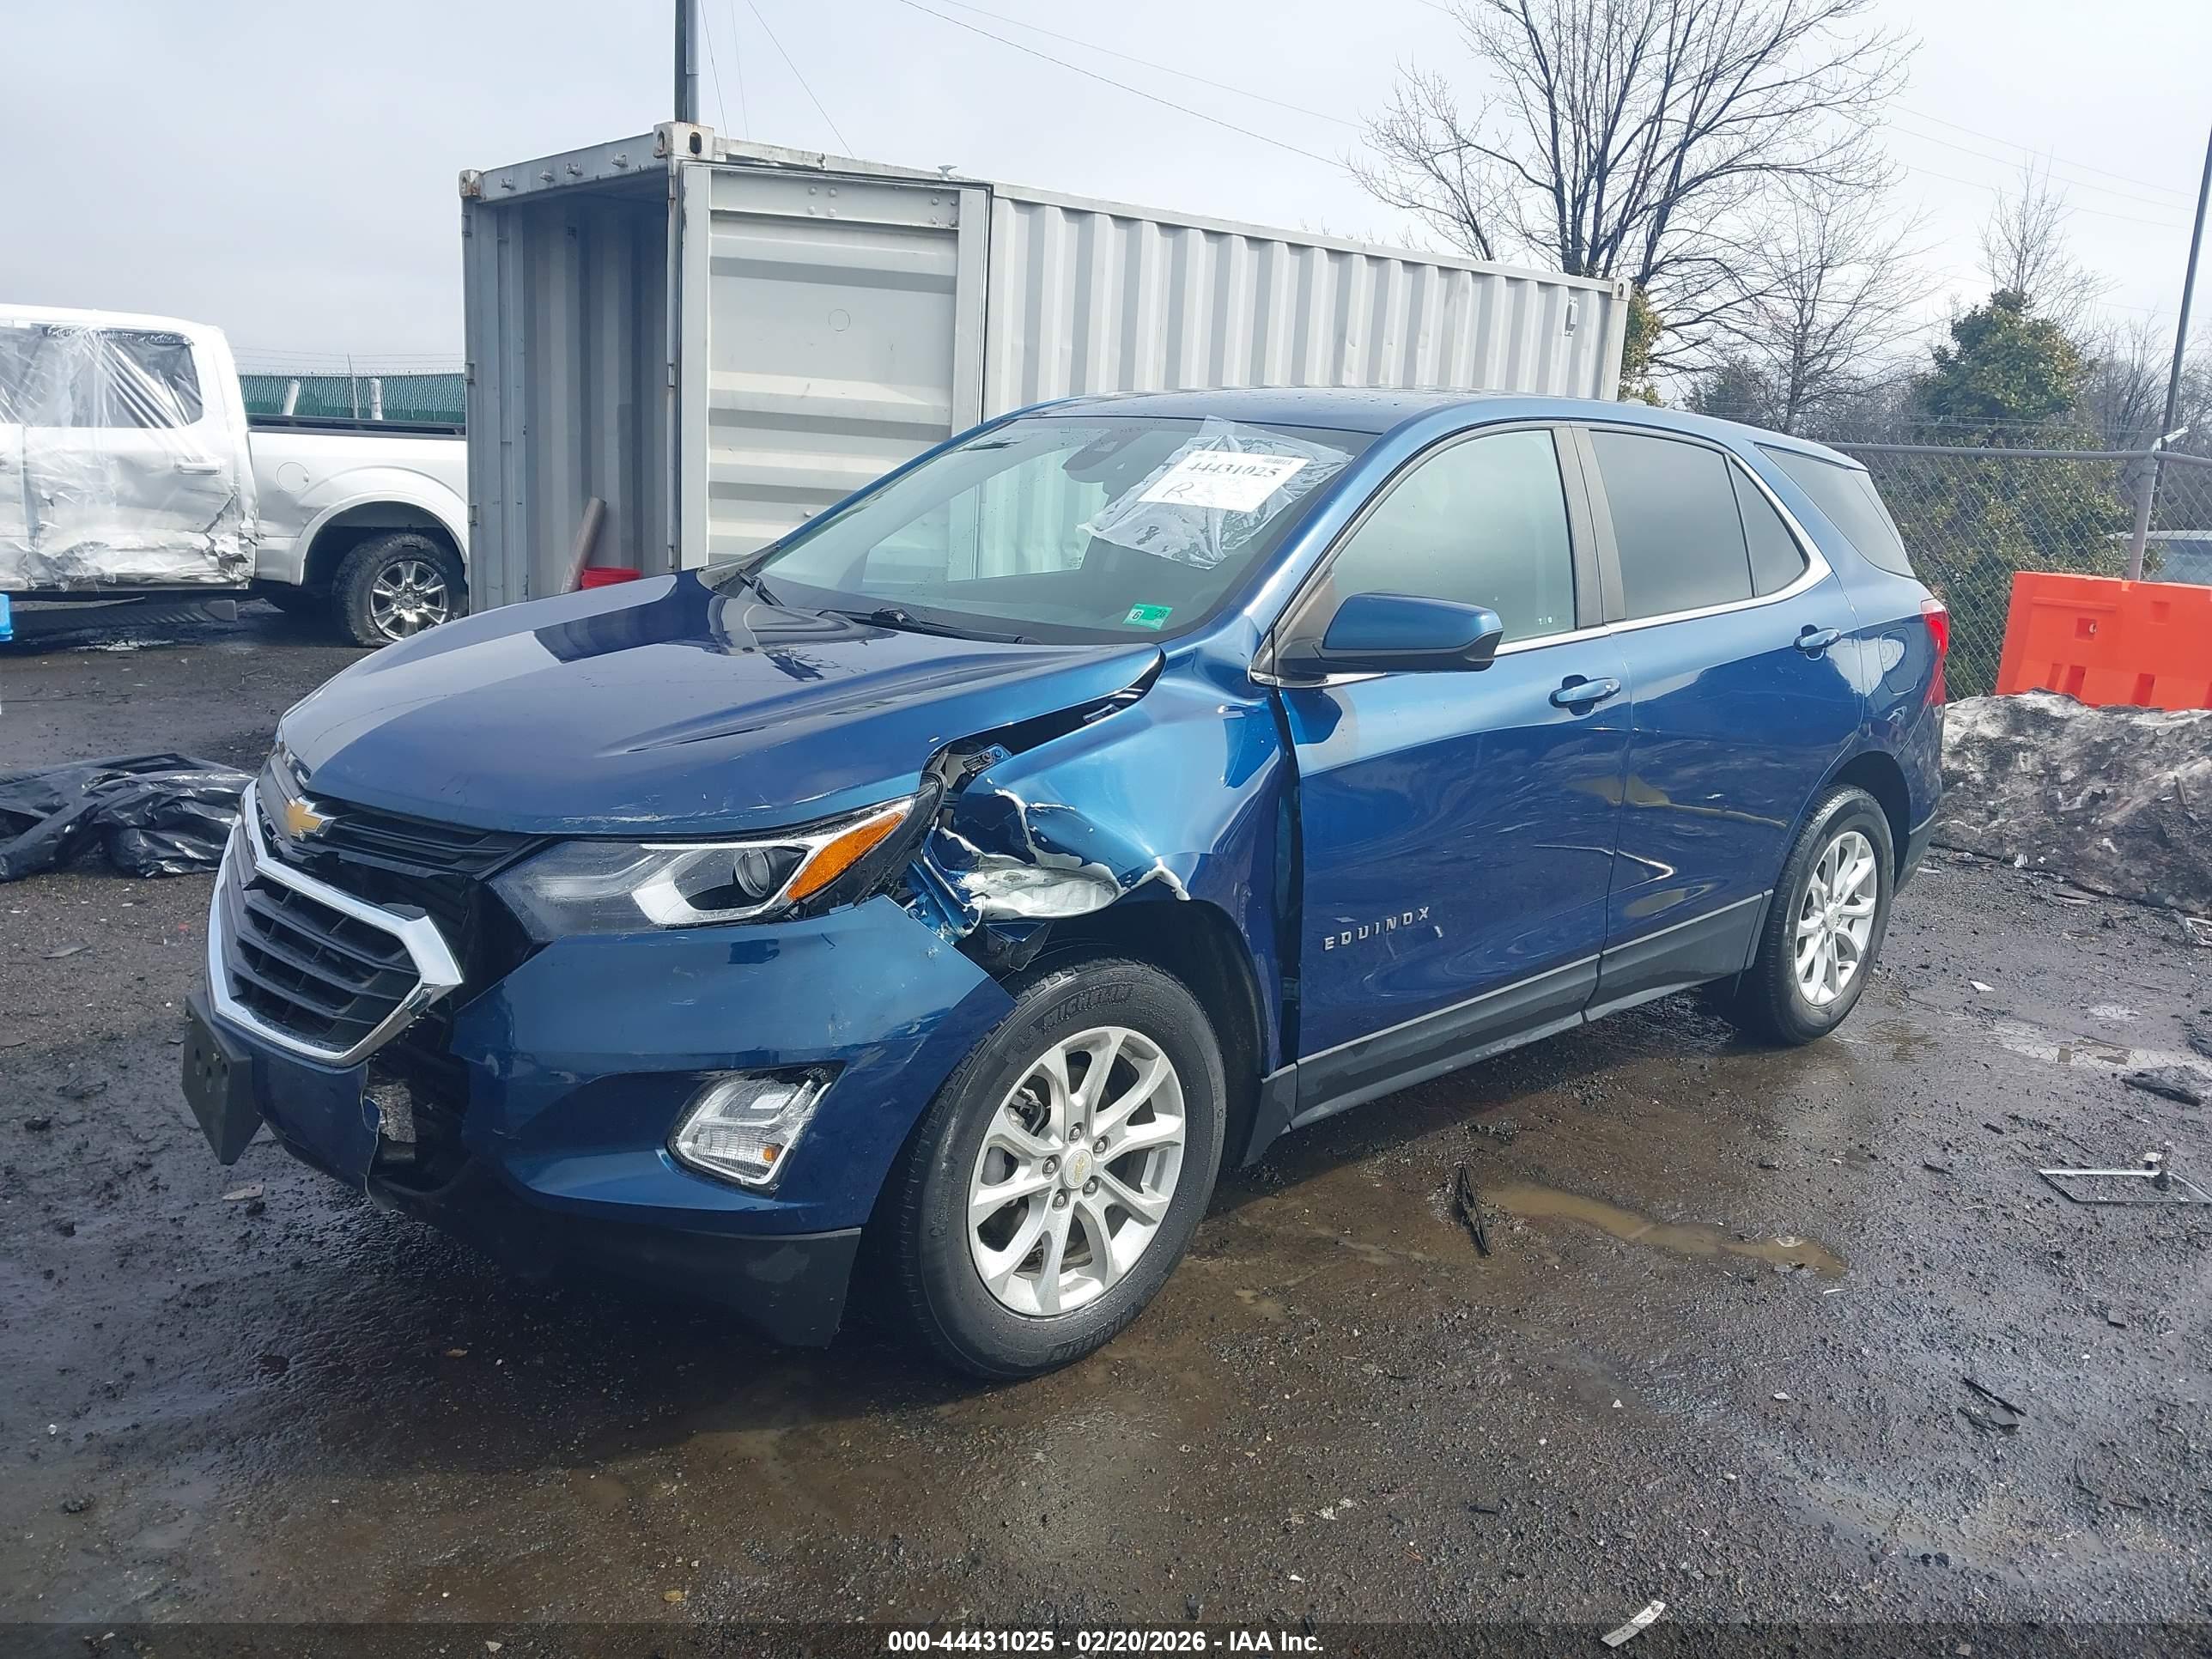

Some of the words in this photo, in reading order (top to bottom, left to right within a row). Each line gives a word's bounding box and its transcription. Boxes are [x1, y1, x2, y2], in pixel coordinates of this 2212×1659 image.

[1187, 461, 1282, 478] 44431025
[1162, 481, 1194, 499] R
[1132, 611, 1142, 620] 6
[1323, 906, 1430, 951] EQUINOX
